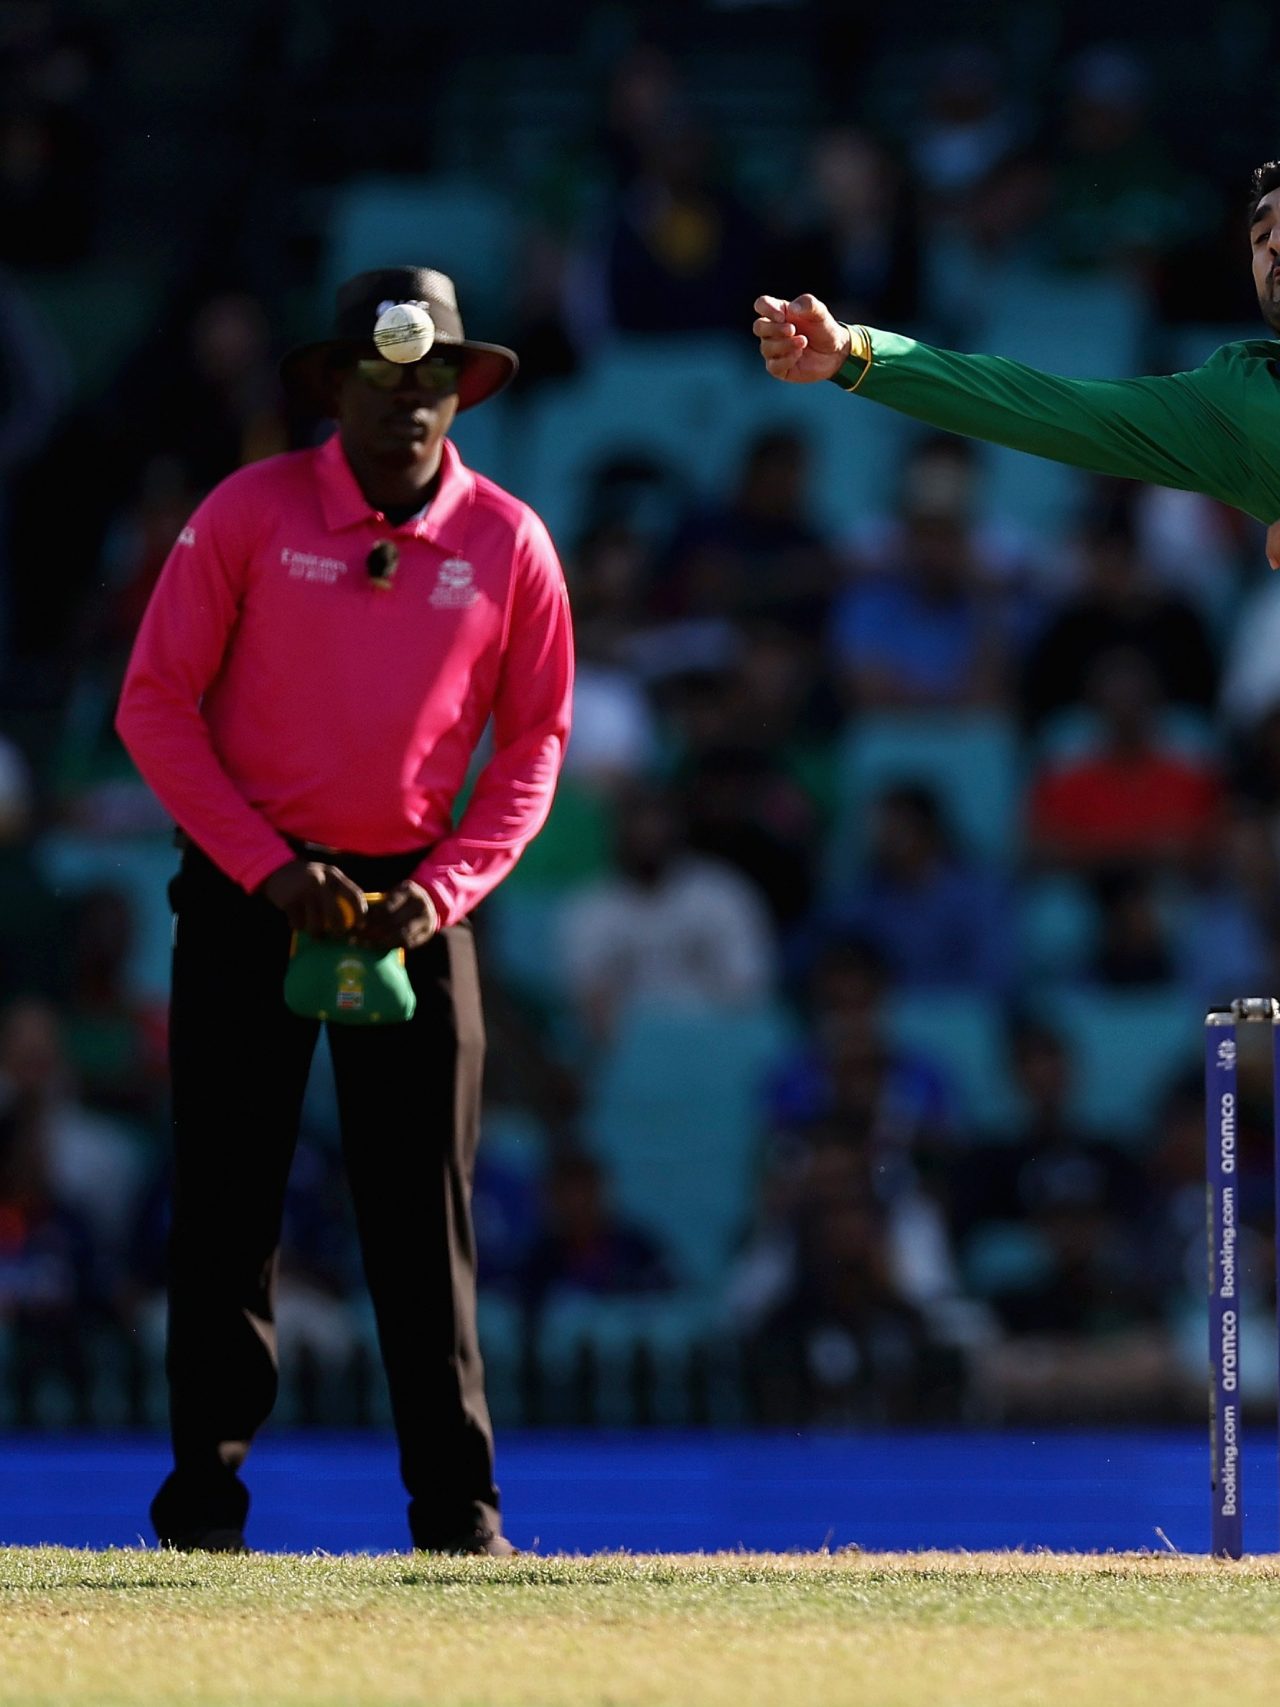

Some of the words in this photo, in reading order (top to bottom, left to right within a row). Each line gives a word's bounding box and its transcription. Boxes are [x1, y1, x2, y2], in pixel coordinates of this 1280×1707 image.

[1221, 1092, 1235, 1174] aramco
[1220, 1187, 1236, 1298] Booking.com
[1222, 1310, 1237, 1391] aramco
[1221, 1405, 1238, 1516] Booking.com
